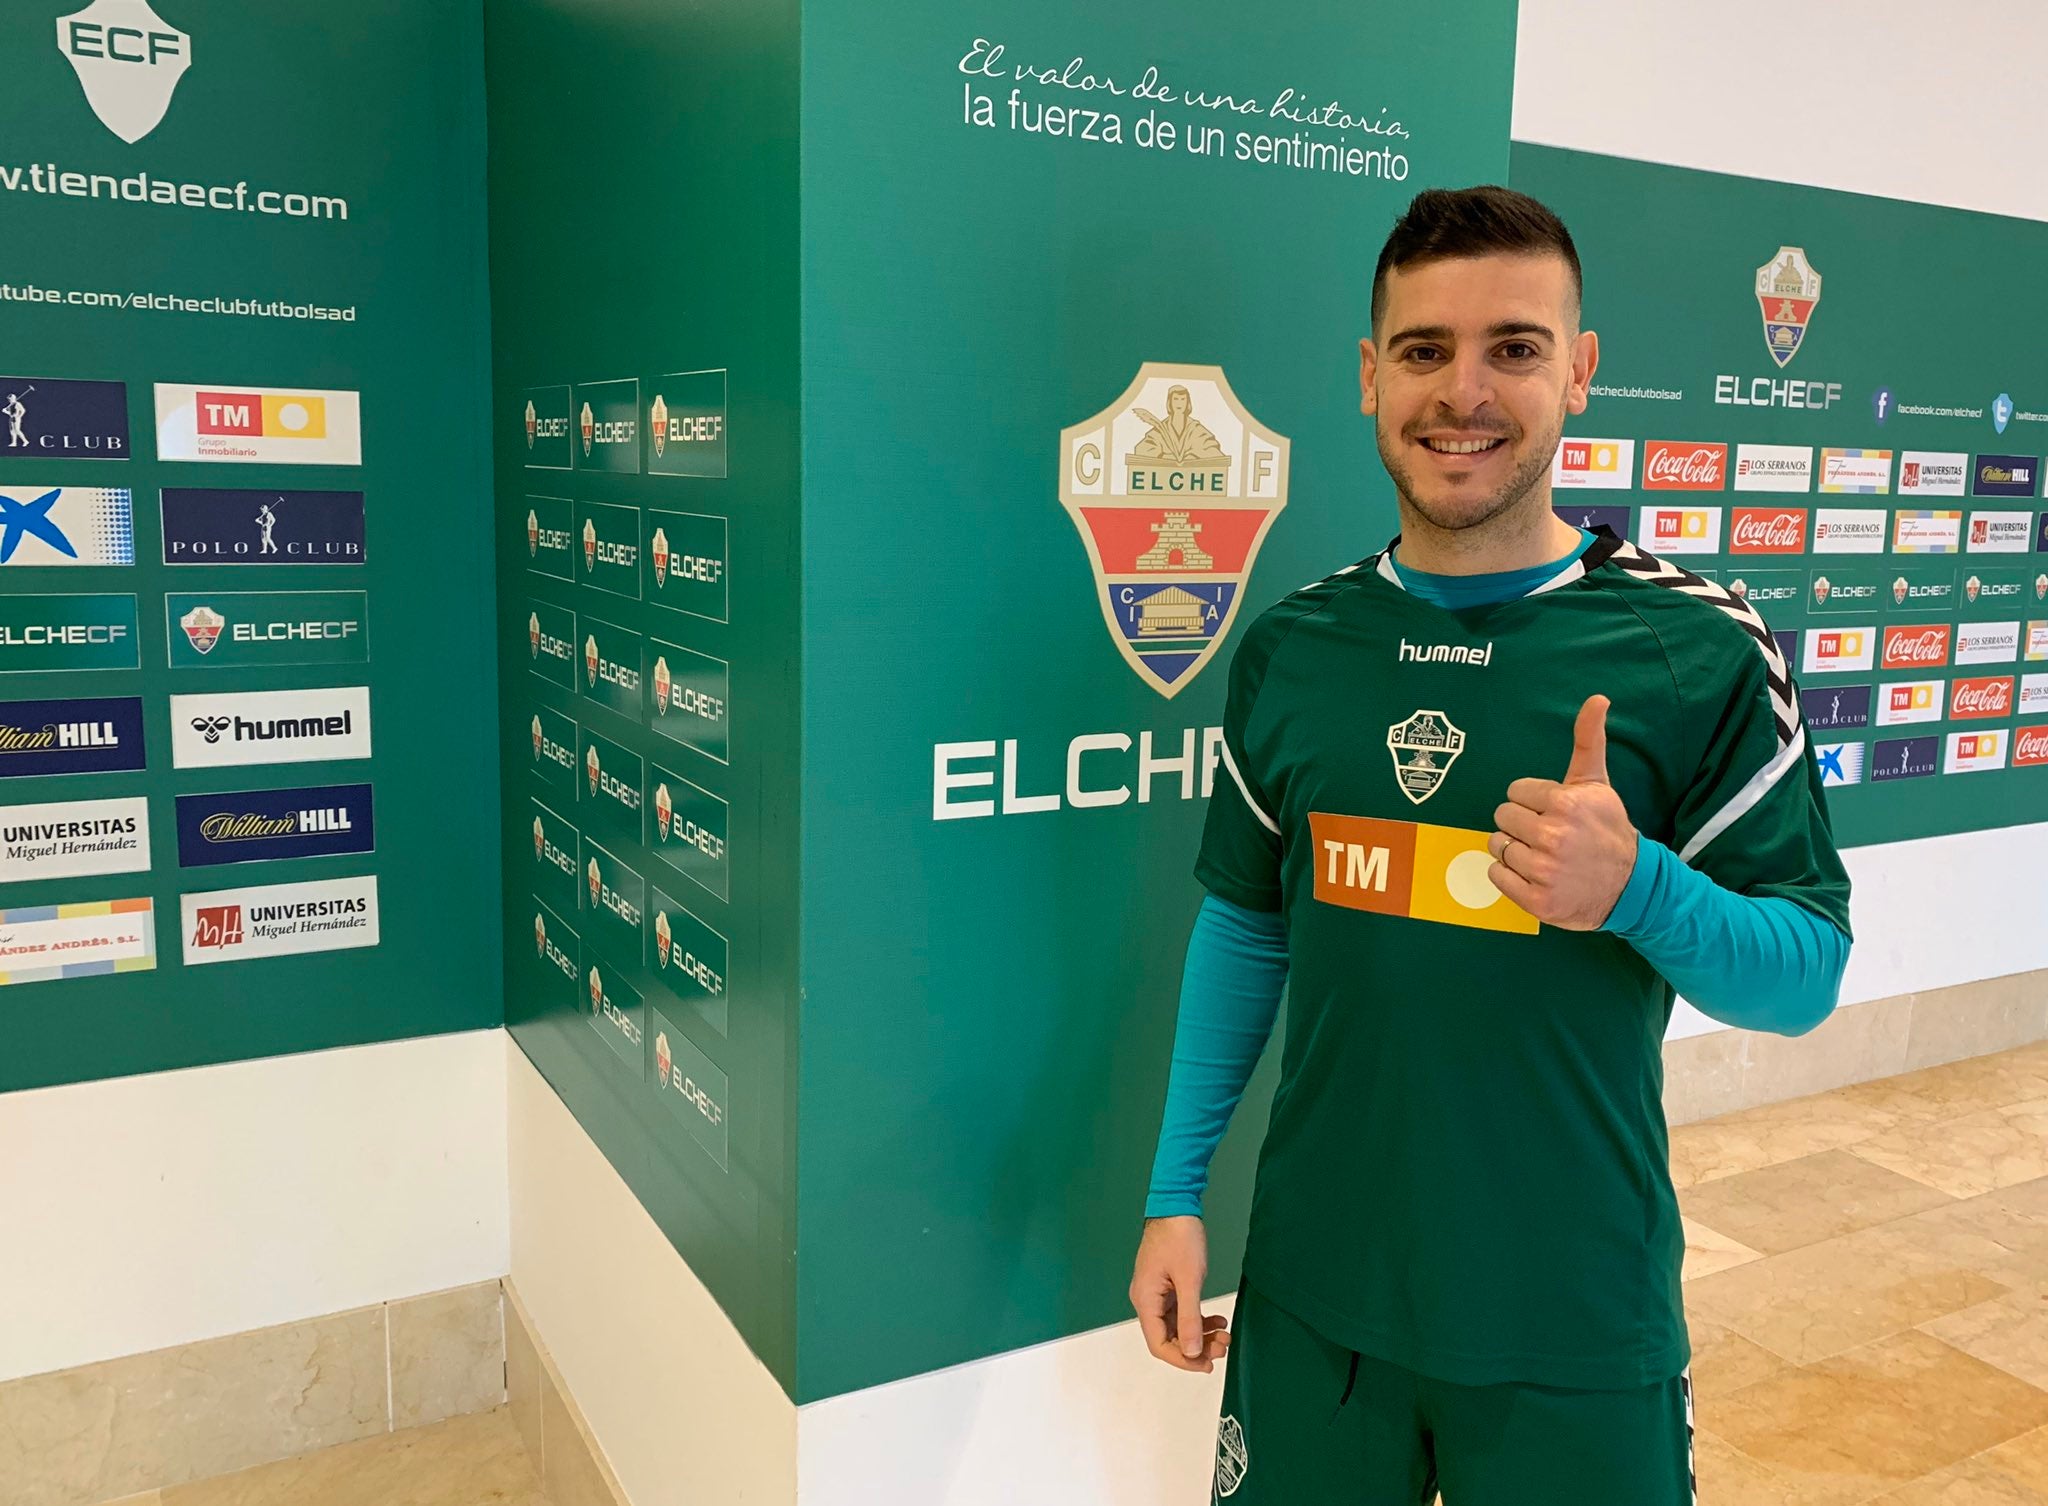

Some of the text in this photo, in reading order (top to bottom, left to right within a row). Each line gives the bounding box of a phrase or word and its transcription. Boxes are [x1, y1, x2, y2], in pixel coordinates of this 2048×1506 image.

[69, 21, 180, 65] ECF
[958, 37, 1410, 141] El valor de una historia,
[964, 83, 1410, 182] la fuerza de un sentimiento
[1775, 284, 1802, 294] ELCHE
[0, 283, 356, 321] tube.com/elcheclubfutbolsad
[1715, 375, 1842, 410] ELCHECF
[204, 403, 250, 428] TM
[1898, 404, 1983, 418] facebook.com/elchecf
[536, 418, 568, 437] ELCHECF
[595, 421, 635, 443] ELCHECF
[670, 416, 722, 441] ELCHECF
[39, 435, 122, 450] CLUB
[198, 437, 227, 447] Grupo
[198, 447, 257, 457] Inmobiliario
[1074, 443, 1101, 486] C
[1566, 450, 1586, 466] TM
[1648, 448, 1723, 484] Coca-Cola
[1750, 460, 1806, 471] LOS SERRANOS
[1131, 471, 1224, 492] ELCHE
[1252, 451, 1274, 492] F
[1922, 466, 1962, 476] UNIVERSITAS
[2012, 468, 2029, 482] HILL
[1659, 518, 1677, 533] TM
[1733, 513, 1803, 547] Coca-Cola
[1828, 524, 1880, 533] LOS SERRANOS
[1990, 522, 2027, 532] UNIVERSITAS
[172, 541, 360, 555] POLO CLUB
[539, 528, 571, 550] ELCHECF
[597, 540, 637, 567] ELCHECF
[670, 552, 722, 583] ELCHECF
[1120, 587, 1134, 604] C
[1748, 587, 1797, 600] ELCHECF
[1831, 586, 1876, 598] ELCHECF
[1909, 585, 1951, 597] ELCHECF
[1981, 584, 2021, 596] ELCHECF
[1206, 604, 1219, 620] A
[0, 625, 127, 645] LCHECF
[233, 621, 357, 641] ELCHECF
[1968, 635, 2014, 646] LOS SERRANOS
[541, 633, 573, 661] ELCHECF
[1399, 638, 1493, 666] hummel
[1821, 640, 1836, 653] TM
[1886, 630, 1947, 663] Coca-Cola
[599, 658, 639, 690] ELCHECF
[672, 684, 724, 721] ELCHECF
[1894, 693, 1908, 706] TM
[1953, 682, 2011, 714] Coca-Cola
[234, 710, 351, 741] hummel
[1808, 714, 1867, 726] OLO CLUB
[59, 722, 119, 747] HILL
[1393, 729, 1402, 742] C
[1410, 738, 1443, 746] ELCHE
[1450, 735, 1459, 748] F
[543, 737, 575, 770] ELCHECF
[1960, 742, 1974, 755] TM
[1873, 764, 1935, 777] POLO CLUB
[601, 771, 640, 810] ELCHECF
[3, 817, 137, 843] UNIVERSITAS
[200, 808, 352, 843] William HILL
[673, 813, 724, 860] ELCHECF
[5, 837, 137, 862] Miguel Hernández
[1324, 839, 1391, 893] TM
[250, 898, 366, 922] UNIVERSITAS
[602, 884, 641, 928] ELCHECF
[252, 916, 367, 939] Miguel Hernández
[673, 942, 722, 996] ELCHECF
[603, 996, 641, 1047] ELCHECF
[673, 1065, 722, 1126] ELCHECF
